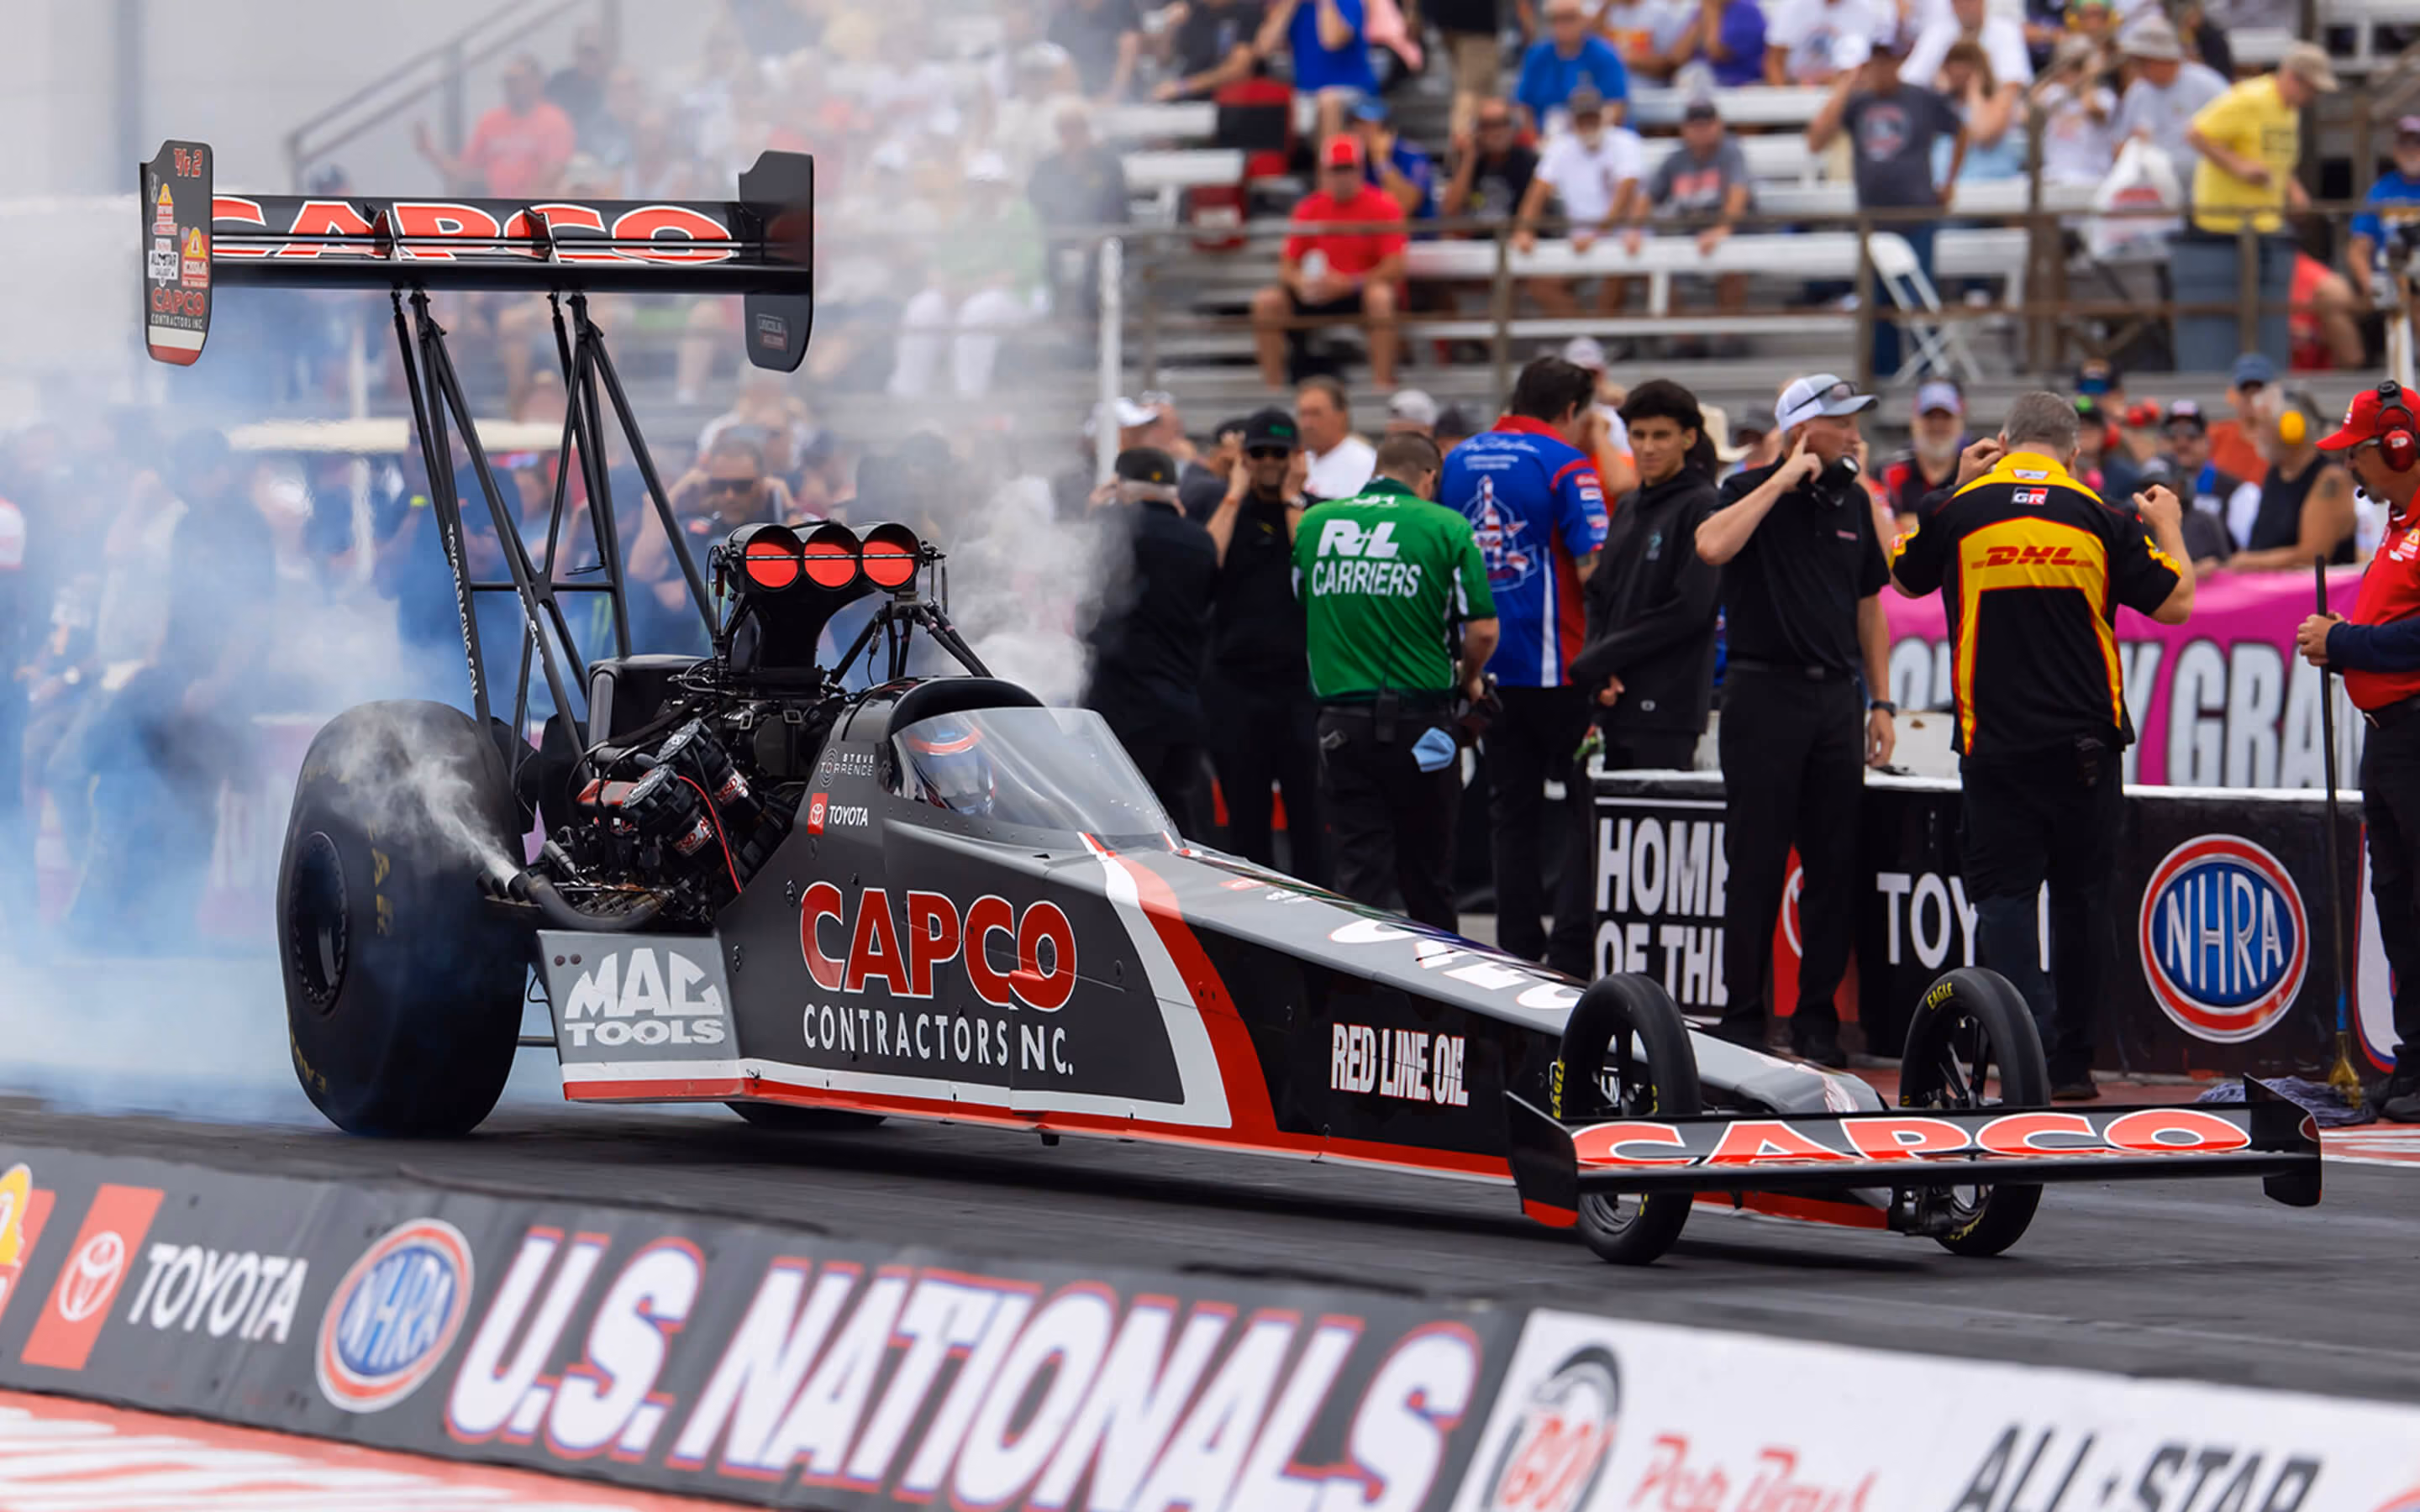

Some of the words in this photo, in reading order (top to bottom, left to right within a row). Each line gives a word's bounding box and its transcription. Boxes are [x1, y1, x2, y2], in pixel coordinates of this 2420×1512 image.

[191, 150, 203, 178] 2
[213, 197, 734, 265] CAPCO
[150, 287, 205, 317] CAPCO
[150, 313, 192, 328] CONTRACTORS
[2013, 492, 2044, 505] GR
[1312, 560, 1422, 598] CARRIERS
[1985, 545, 2079, 566] DHL
[820, 761, 873, 776] TORRENCE
[843, 753, 874, 764] STEVE
[829, 806, 868, 827] TOYOTA
[800, 880, 1078, 1013] CAPCO
[2165, 870, 2285, 995] NHRA
[564, 948, 724, 1019] MAC
[1927, 982, 1954, 1010] EAGLE
[564, 1019, 726, 1047] TOOLS
[802, 1004, 1008, 1067] CONTRACTORS
[1331, 1022, 1377, 1094] RED
[1379, 1027, 1431, 1102] LINE
[1433, 1032, 1469, 1107] OIL
[1553, 1056, 1565, 1120] EAGLE
[1571, 1109, 2251, 1168] CAPCO
[128, 1242, 308, 1343] TOYOTA
[339, 1252, 455, 1372] NHRA
[444, 1225, 707, 1462] U.S.
[666, 1255, 1484, 1512] NATIONALS
